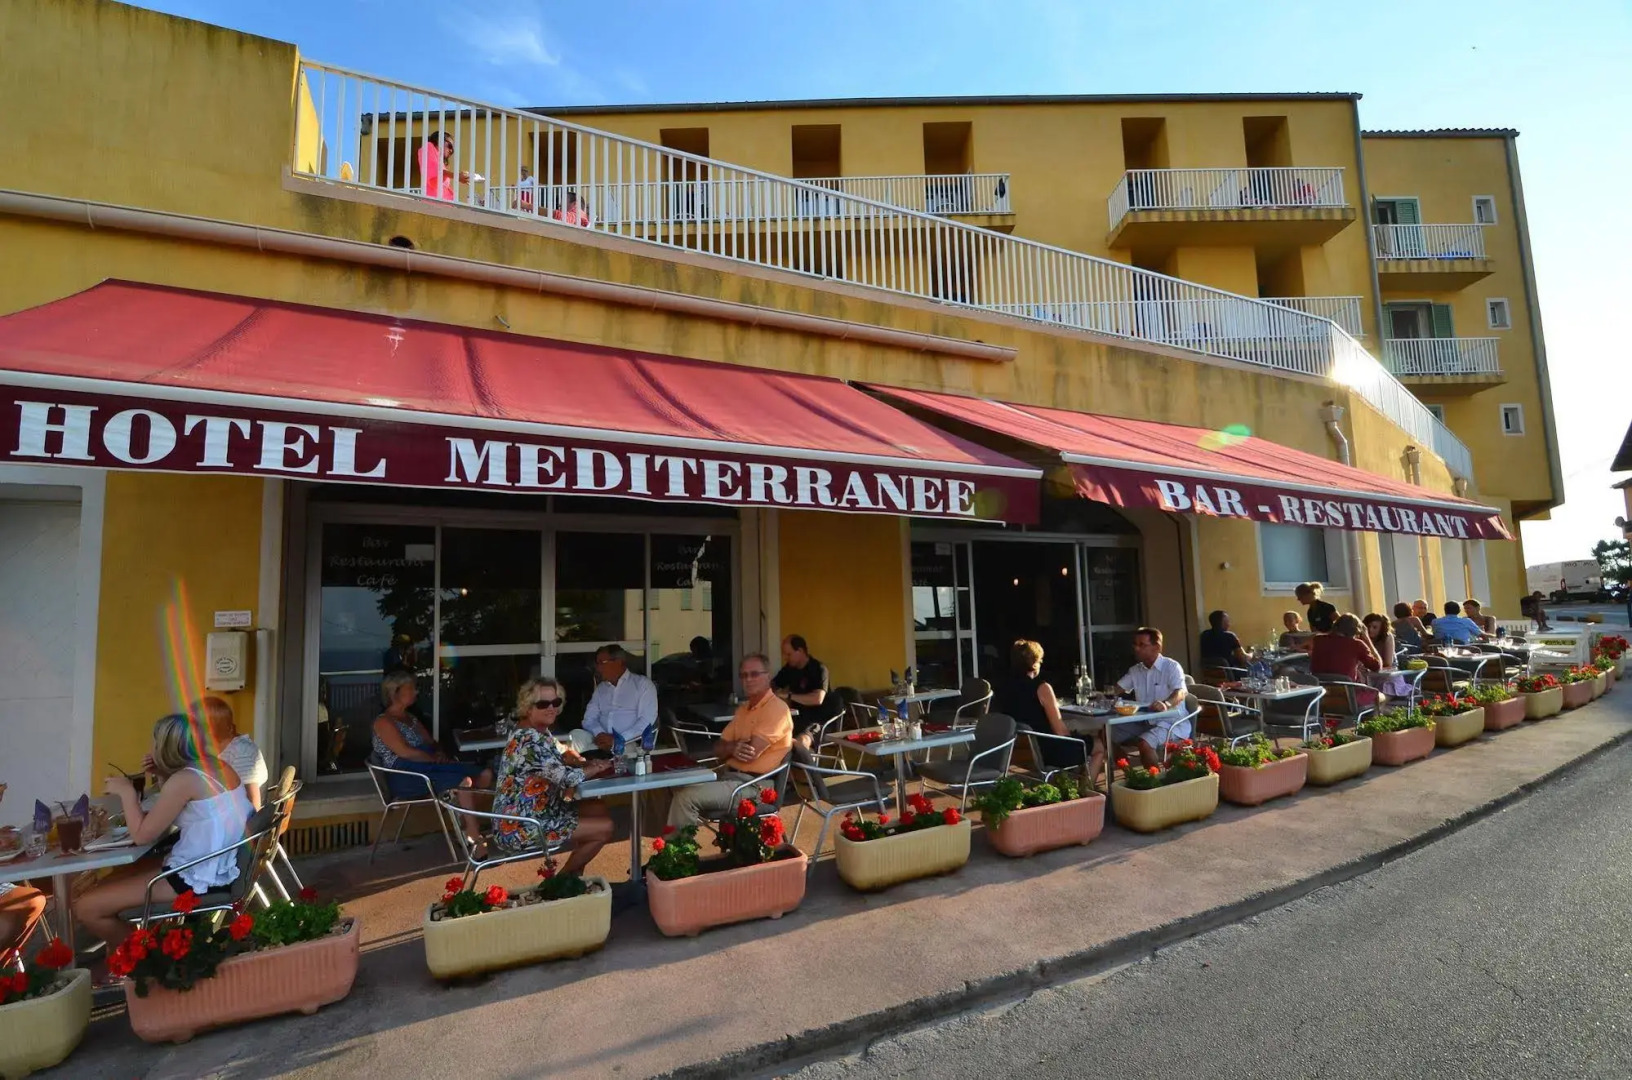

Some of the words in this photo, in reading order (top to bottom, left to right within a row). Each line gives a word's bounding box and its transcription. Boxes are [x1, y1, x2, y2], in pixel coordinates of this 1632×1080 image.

[10, 400, 387, 478] HOTEL
[443, 436, 977, 516] MEDITERRANEE
[1155, 479, 1249, 518] BAR
[1277, 493, 1470, 539] RESTAURANT
